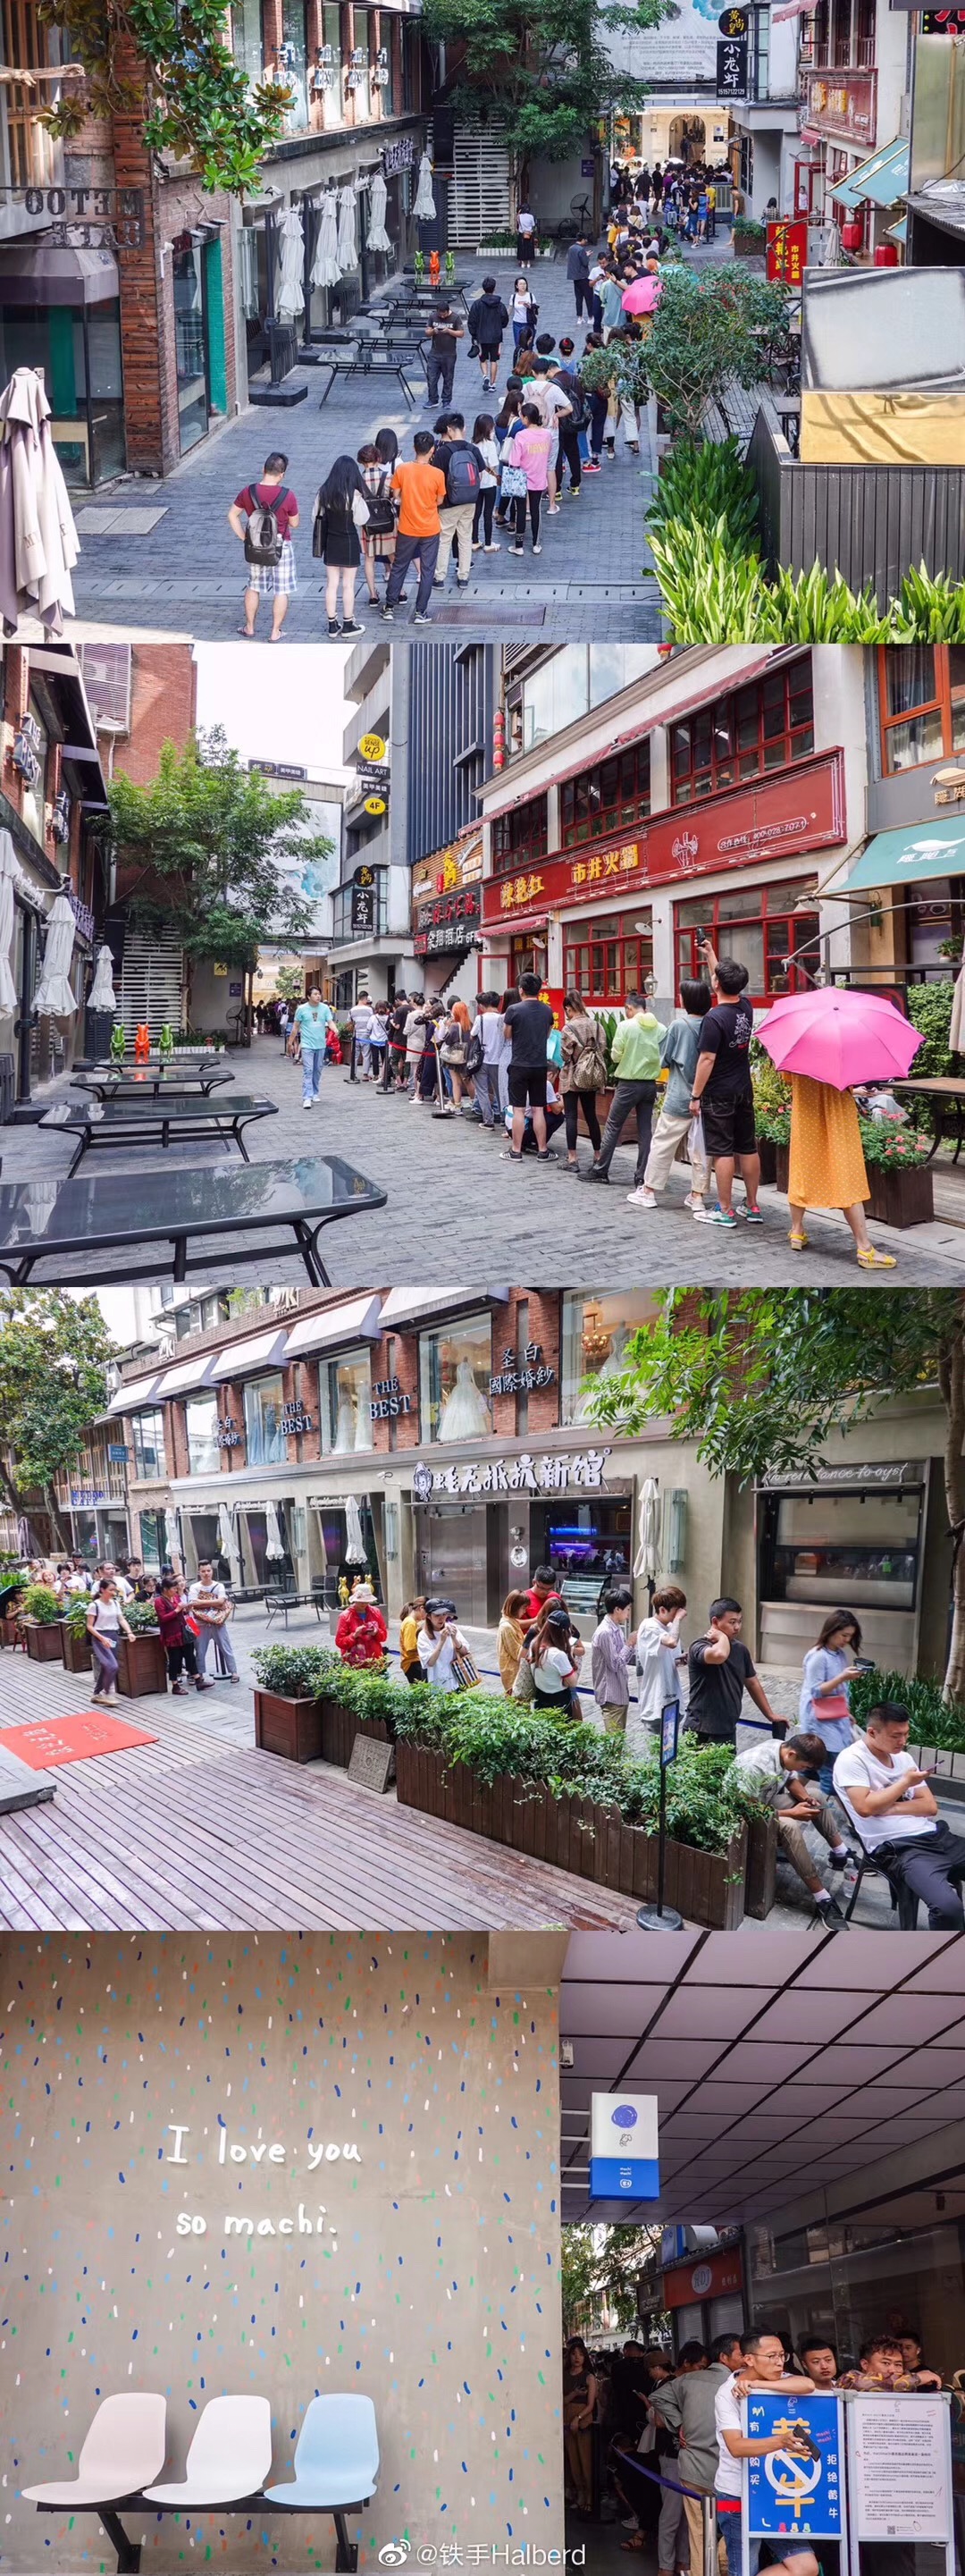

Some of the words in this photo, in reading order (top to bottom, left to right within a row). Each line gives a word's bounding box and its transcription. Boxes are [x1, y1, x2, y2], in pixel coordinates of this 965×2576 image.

[723, 44, 741, 88] 小龙虾
[357, 765, 373, 774] NAIL
[374, 768, 387, 776] ART
[369, 802, 381, 810] 4F
[368, 1394, 411, 1419] BEST
[280, 1415, 312, 1435] BEST
[167, 2125, 190, 2164] I
[219, 2127, 286, 2164] love
[307, 2142, 362, 2170] you
[176, 2212, 207, 2235] so
[224, 2203, 338, 2235] machi.
[749, 2420, 760, 2486] 有购买
[827, 2454, 838, 2519] 拒绝黄牛
